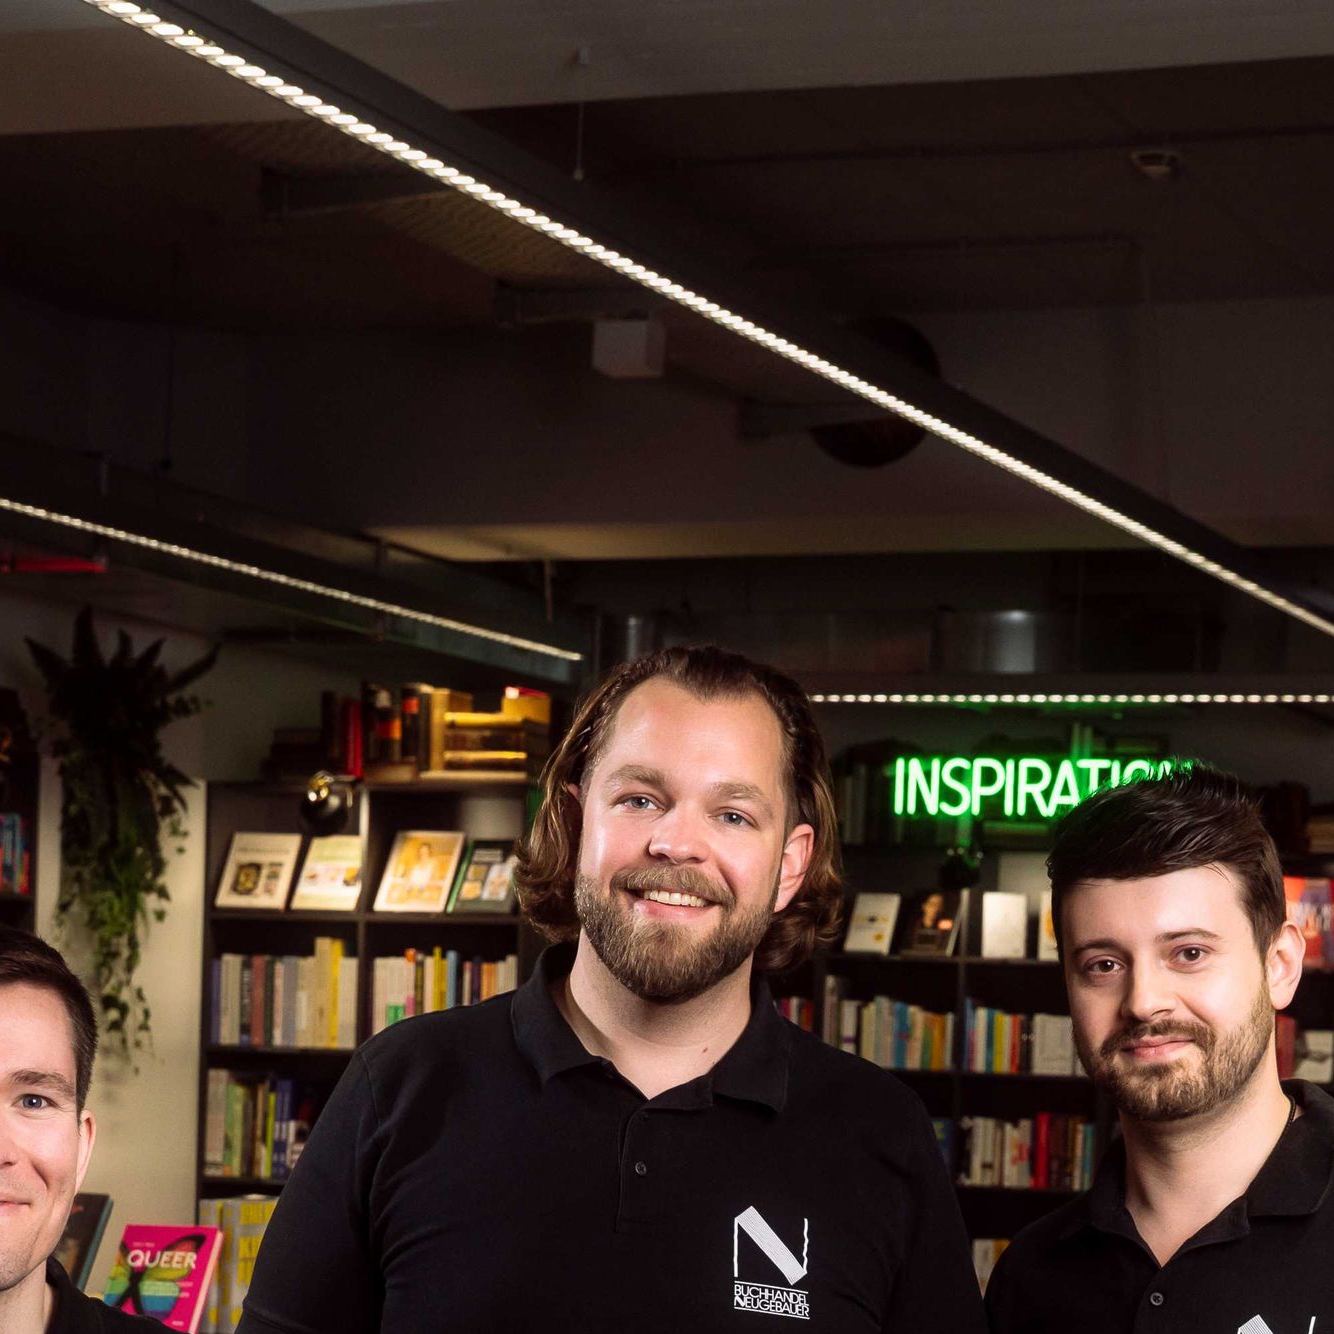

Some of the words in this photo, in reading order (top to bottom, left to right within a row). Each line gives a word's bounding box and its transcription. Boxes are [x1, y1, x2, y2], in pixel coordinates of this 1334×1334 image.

[127, 1249, 197, 1270] QUEER
[733, 1284, 809, 1306] BUCHHANDEL
[733, 1295, 810, 1317] NEUGEBAUER
